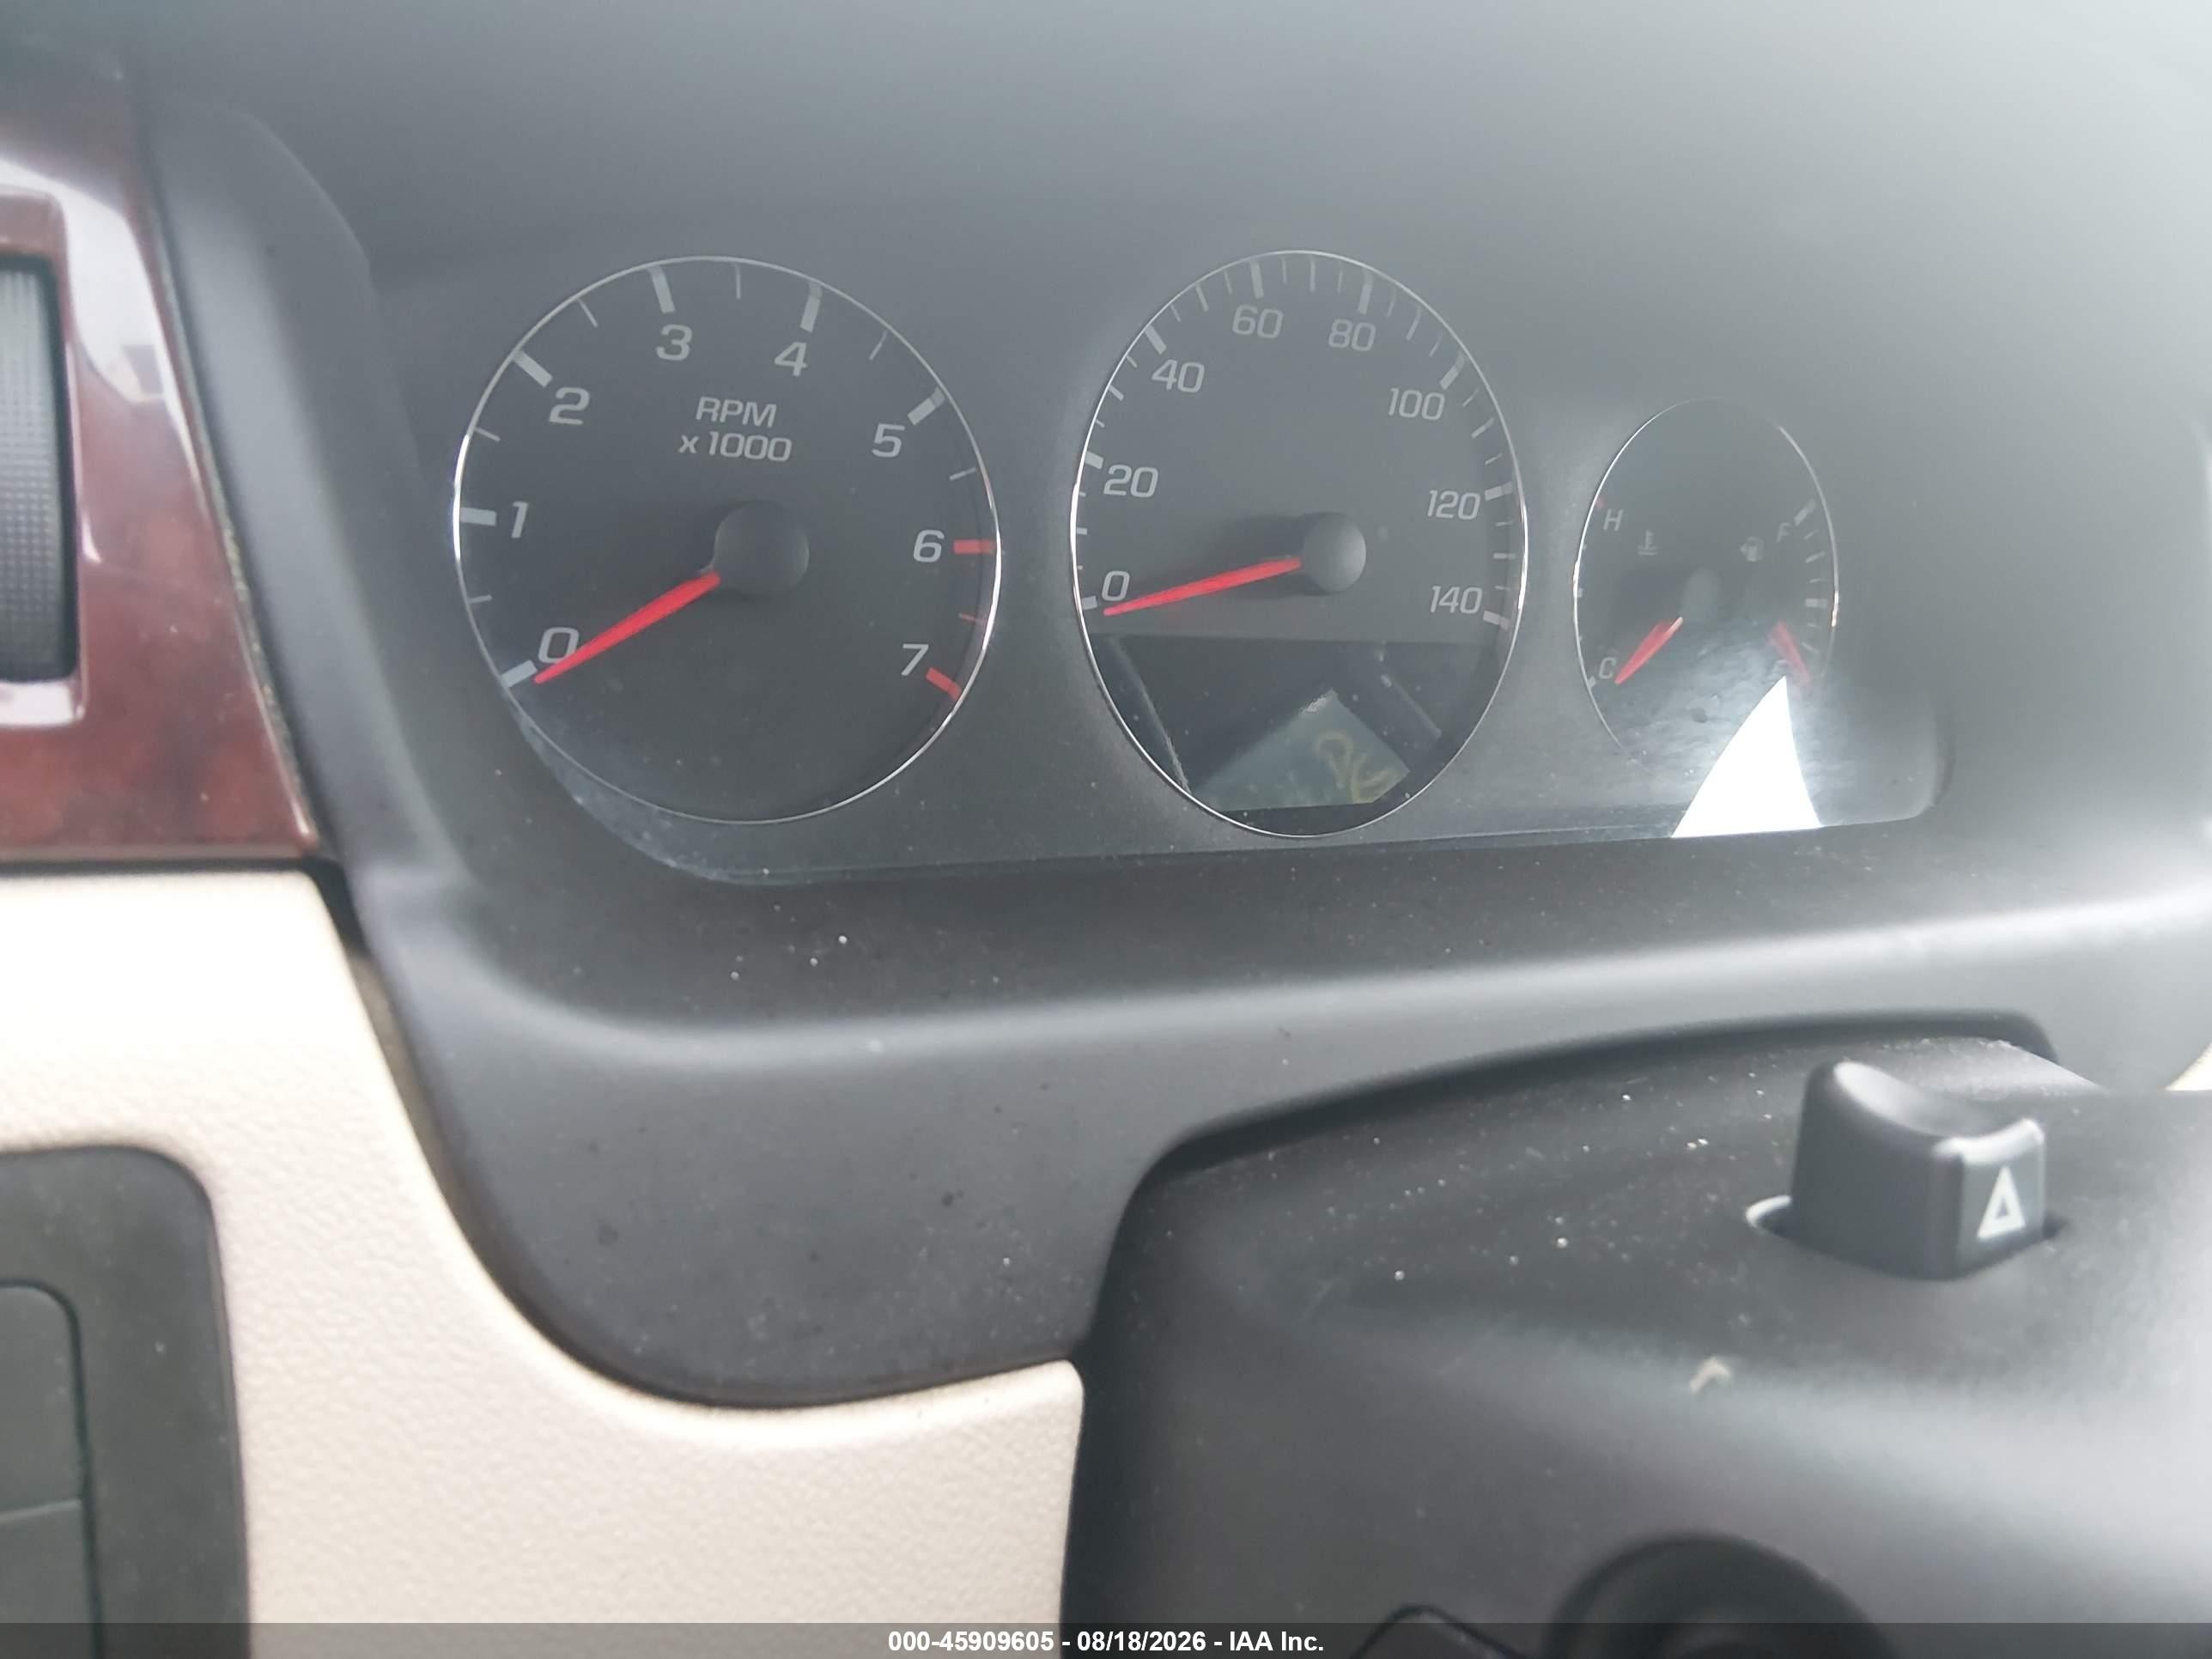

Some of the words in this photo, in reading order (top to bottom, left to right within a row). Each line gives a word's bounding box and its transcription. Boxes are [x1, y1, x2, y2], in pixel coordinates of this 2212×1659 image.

[1232, 305, 1283, 338] 60
[1328, 319, 1376, 351] 80
[655, 325, 693, 361] 3
[775, 342, 808, 376] 4
[1152, 360, 1205, 392] 40
[549, 387, 590, 425] 2
[696, 397, 777, 428] RPM
[1388, 388, 1445, 421] 100
[872, 424, 905, 458] 5
[1103, 465, 1159, 498] 20
[511, 501, 528, 538] 1
[1427, 489, 1480, 520] 120
[1603, 509, 1624, 531] H
[913, 530, 943, 562] 6
[1101, 570, 1130, 601] 0
[1429, 586, 1483, 615] 140
[538, 627, 580, 665] 0
[901, 643, 930, 677] 7
[1598, 657, 1618, 679] C
